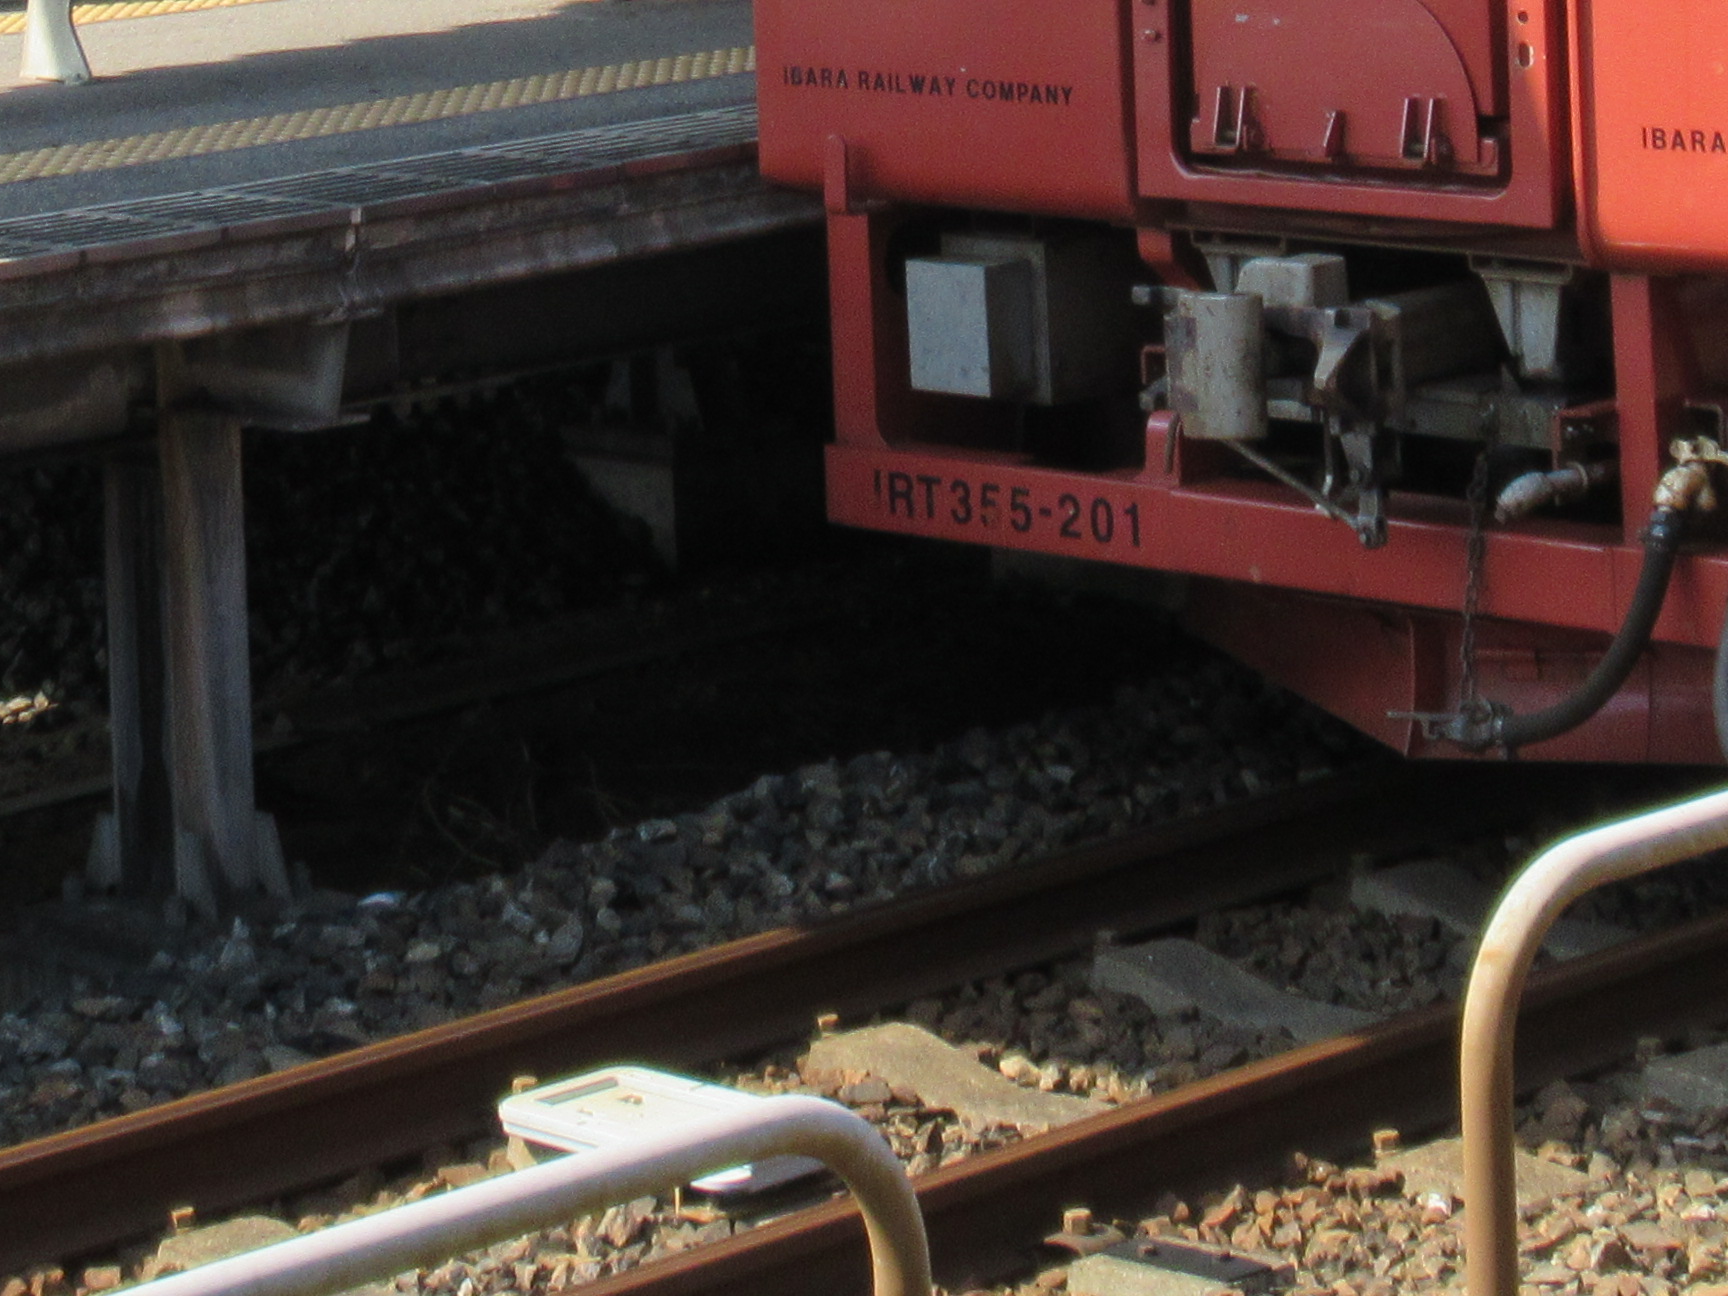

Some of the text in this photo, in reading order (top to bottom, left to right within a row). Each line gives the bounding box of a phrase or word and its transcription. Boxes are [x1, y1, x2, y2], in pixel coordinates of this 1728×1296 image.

[782, 65, 1075, 107] IBARA RAILWAY COMPANY
[1641, 126, 1726, 155] IBARA
[873, 468, 1143, 549] IRT355-201
